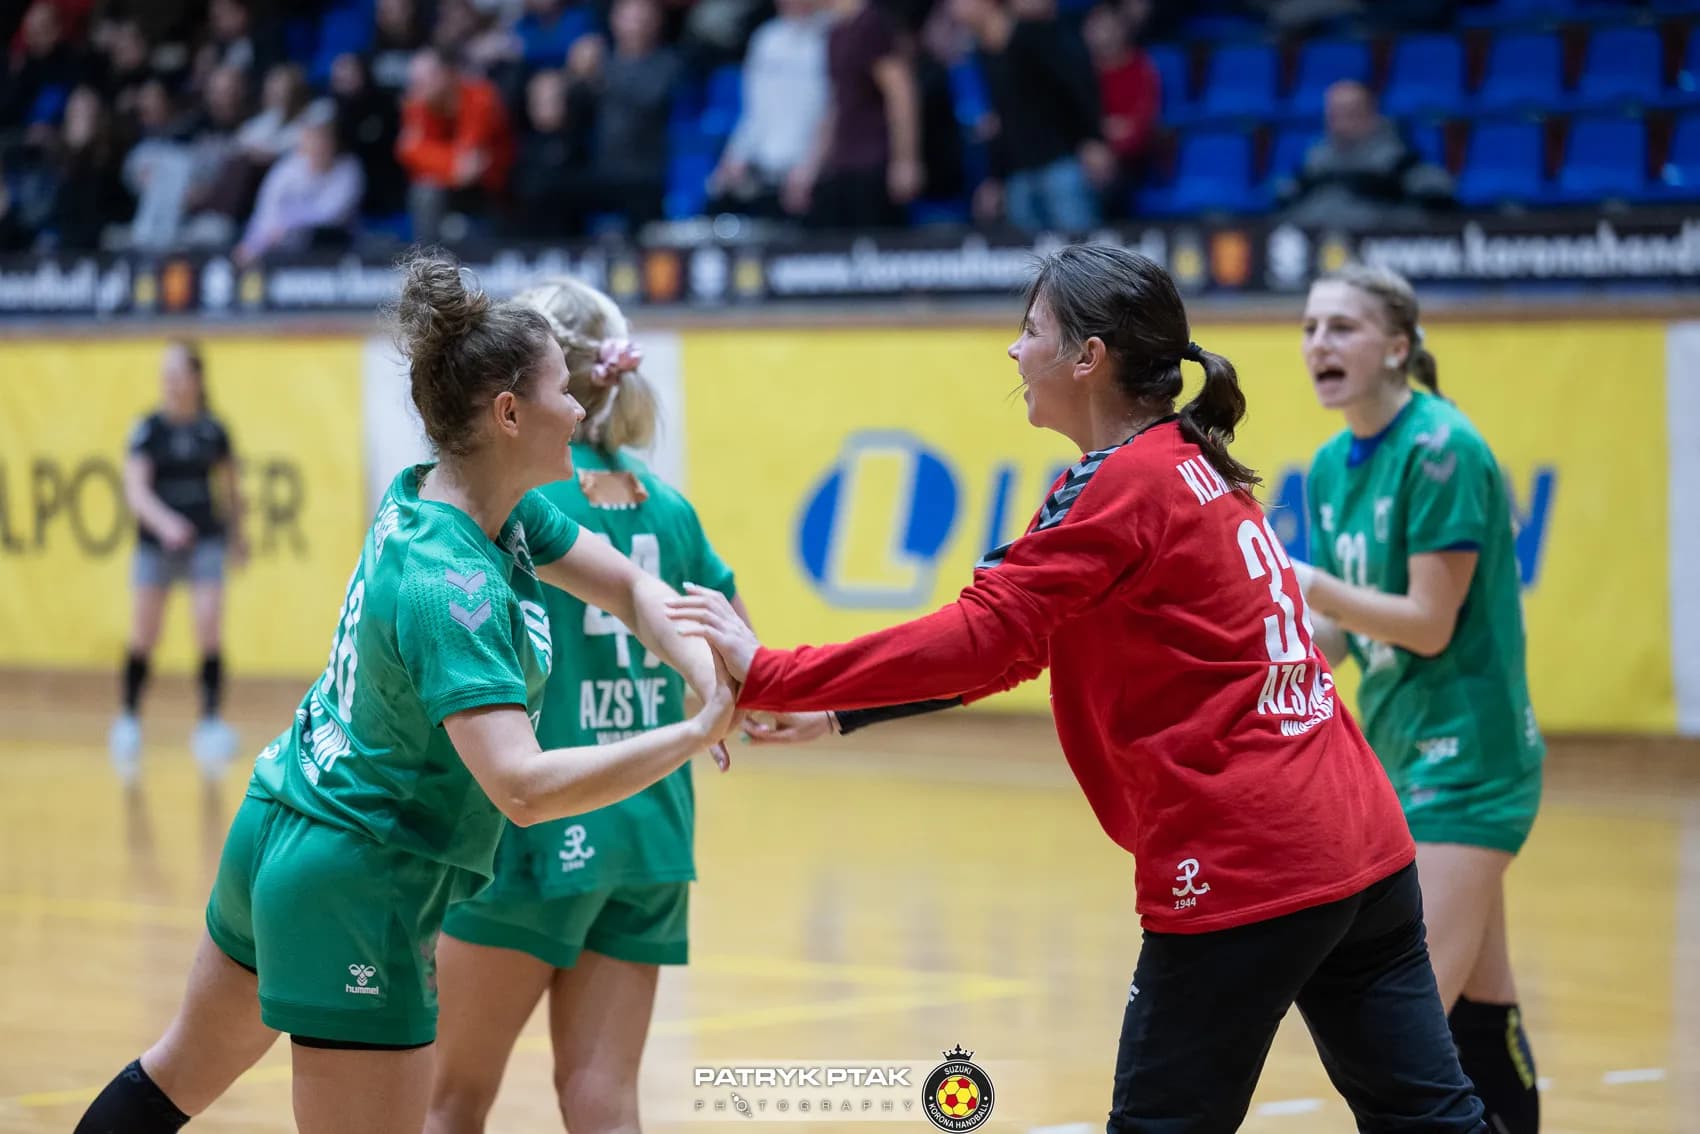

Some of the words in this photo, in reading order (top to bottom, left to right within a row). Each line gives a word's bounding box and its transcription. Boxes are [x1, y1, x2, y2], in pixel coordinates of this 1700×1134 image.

[580, 678, 633, 731] AZS
[1257, 663, 1307, 716] AZS
[1174, 897, 1197, 910] 1944
[345, 983, 380, 995] hummel
